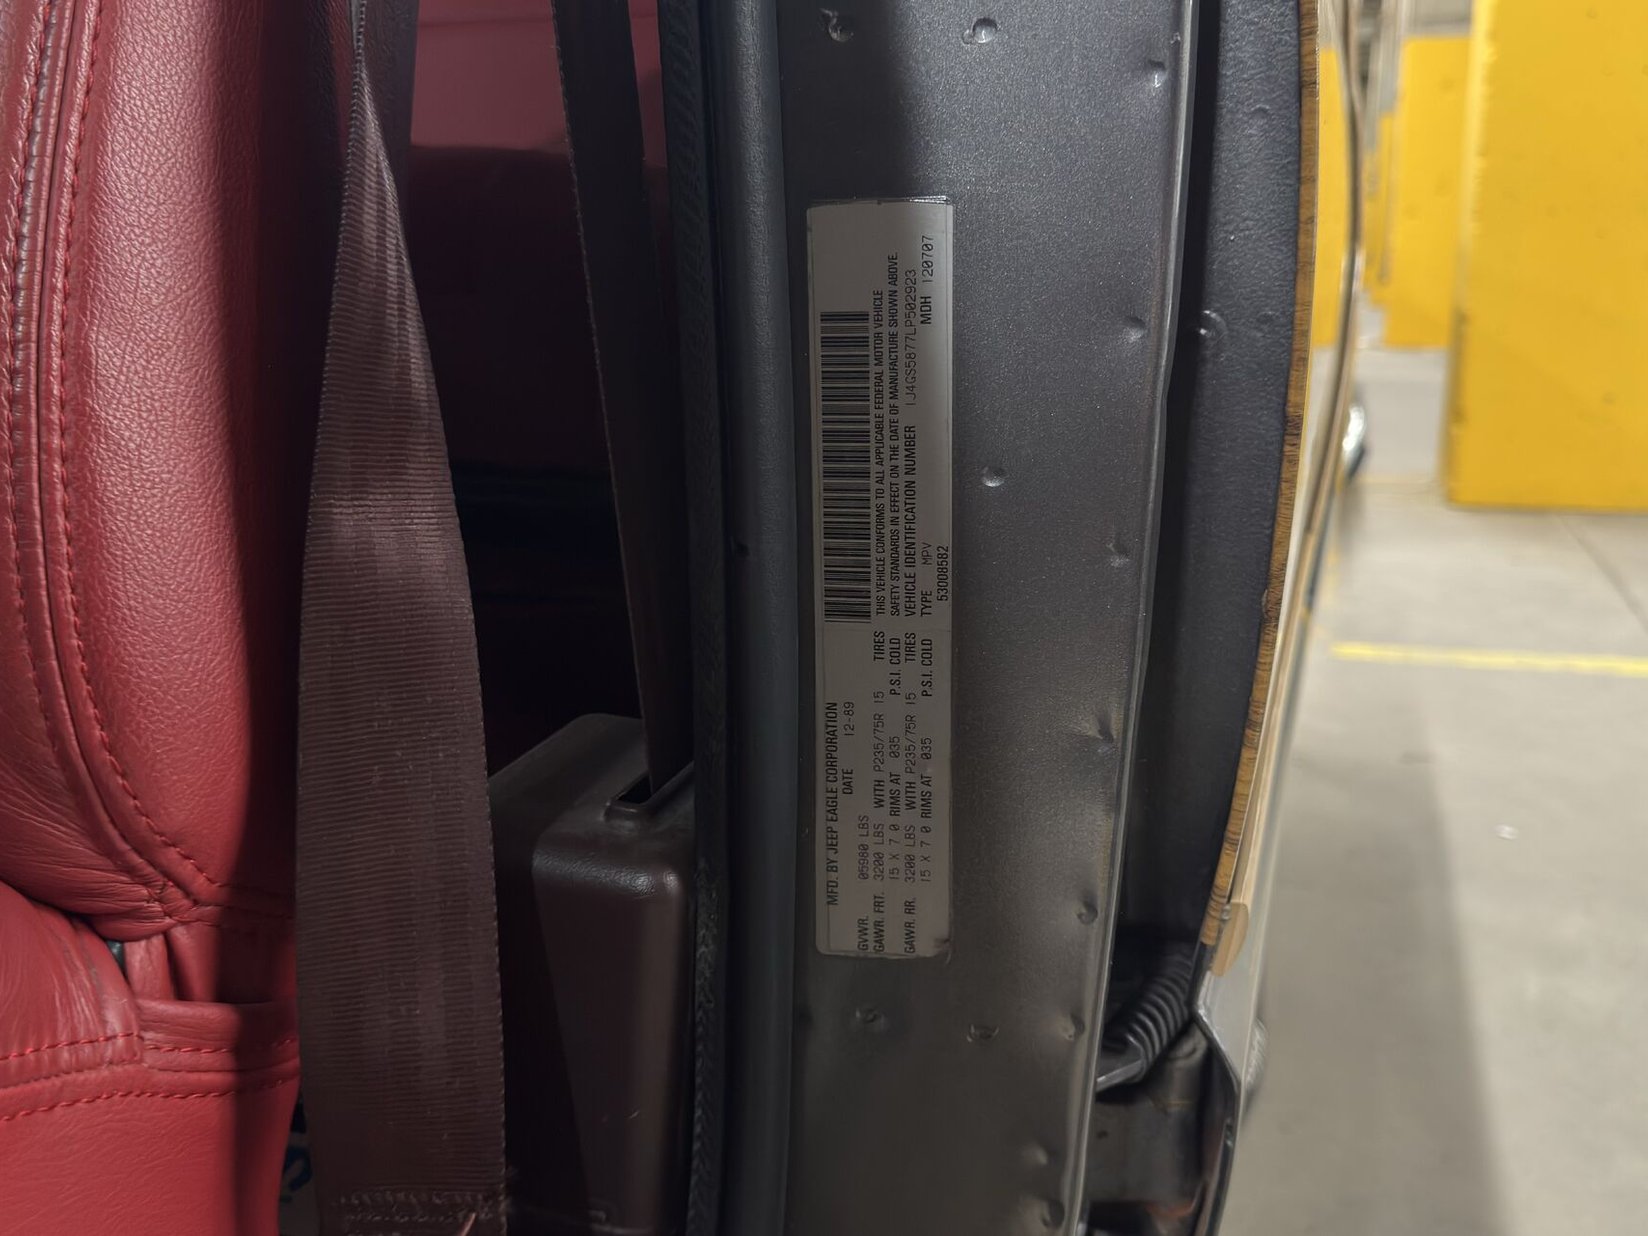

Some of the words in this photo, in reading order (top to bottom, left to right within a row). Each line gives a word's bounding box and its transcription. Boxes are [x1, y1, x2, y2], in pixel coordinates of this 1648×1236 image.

[922, 235, 933, 282] 120707
[873, 290, 883, 328] VEHICLE
[888, 290, 898, 328] SHOWN
[921, 296, 932, 324] MDH
[874, 332, 883, 366] MOTOR
[889, 331, 898, 400] MANUFACTURE
[874, 370, 883, 409] FEDERAL
[889, 403, 899, 414] OF
[875, 414, 884, 466] APPLICABLE
[890, 418, 899, 441] DATE
[890, 444, 899, 461] THE
[904, 426, 915, 475] NUMBER
[876, 470, 884, 485] ALL
[890, 465, 899, 478] ON
[876, 488, 884, 499] TO
[890, 482, 899, 512] EFFECT
[876, 503, 885, 554] CONFORMS
[890, 517, 899, 525] IN
[904, 481, 916, 567] IDENTIFICATION
[890, 529, 899, 581] STANDARDS
[922, 542, 932, 565] MPV
[876, 557, 885, 592] VEHICLE
[937, 546, 948, 601] 53008582
[876, 596, 885, 615] THIS
[890, 584, 900, 616] SAFETY
[905, 572, 916, 616] VEHICLE
[921, 591, 932, 616] TYPE
[874, 631, 884, 661] TIRES
[890, 638, 900, 664] COLD
[905, 633, 916, 663] TIRES
[921, 639, 932, 666] COLD
[890, 670, 900, 695] P.S.I.
[921, 670, 932, 696] P.S.I.
[873, 691, 884, 703] 15
[905, 692, 916, 704] 15
[844, 702, 854, 736] 12-89
[825, 702, 838, 783] CORPORATION
[873, 714, 884, 772] P235/75R
[889, 736, 900, 758] 035
[905, 715, 916, 774] P235/75R
[921, 738, 932, 760] 035
[842, 769, 853, 794] DATE
[890, 772, 900, 785] AT
[921, 774, 932, 787] AT
[826, 787, 838, 822] EAGLE
[874, 780, 884, 808] WITH
[890, 789, 900, 816] RIMS
[905, 782, 916, 810] WITH
[921, 791, 932, 818] RIMS
[858, 815, 869, 837] LBS
[874, 823, 884, 845] LBS
[905, 825, 915, 847] LBS
[826, 827, 838, 854] JEEP
[826, 858, 838, 872] BY
[858, 844, 869, 880] 05980
[874, 852, 884, 880] 3200
[889, 868, 899, 880] 15
[905, 854, 915, 883] 3200
[921, 870, 931, 882] 15
[827, 877, 838, 905] MFD.
[874, 892, 884, 913] FRT.
[905, 898, 915, 914] RR.
[858, 916, 868, 950] GVWR.
[874, 918, 884, 952] GAWR.
[905, 919, 915, 953] GAWR.
